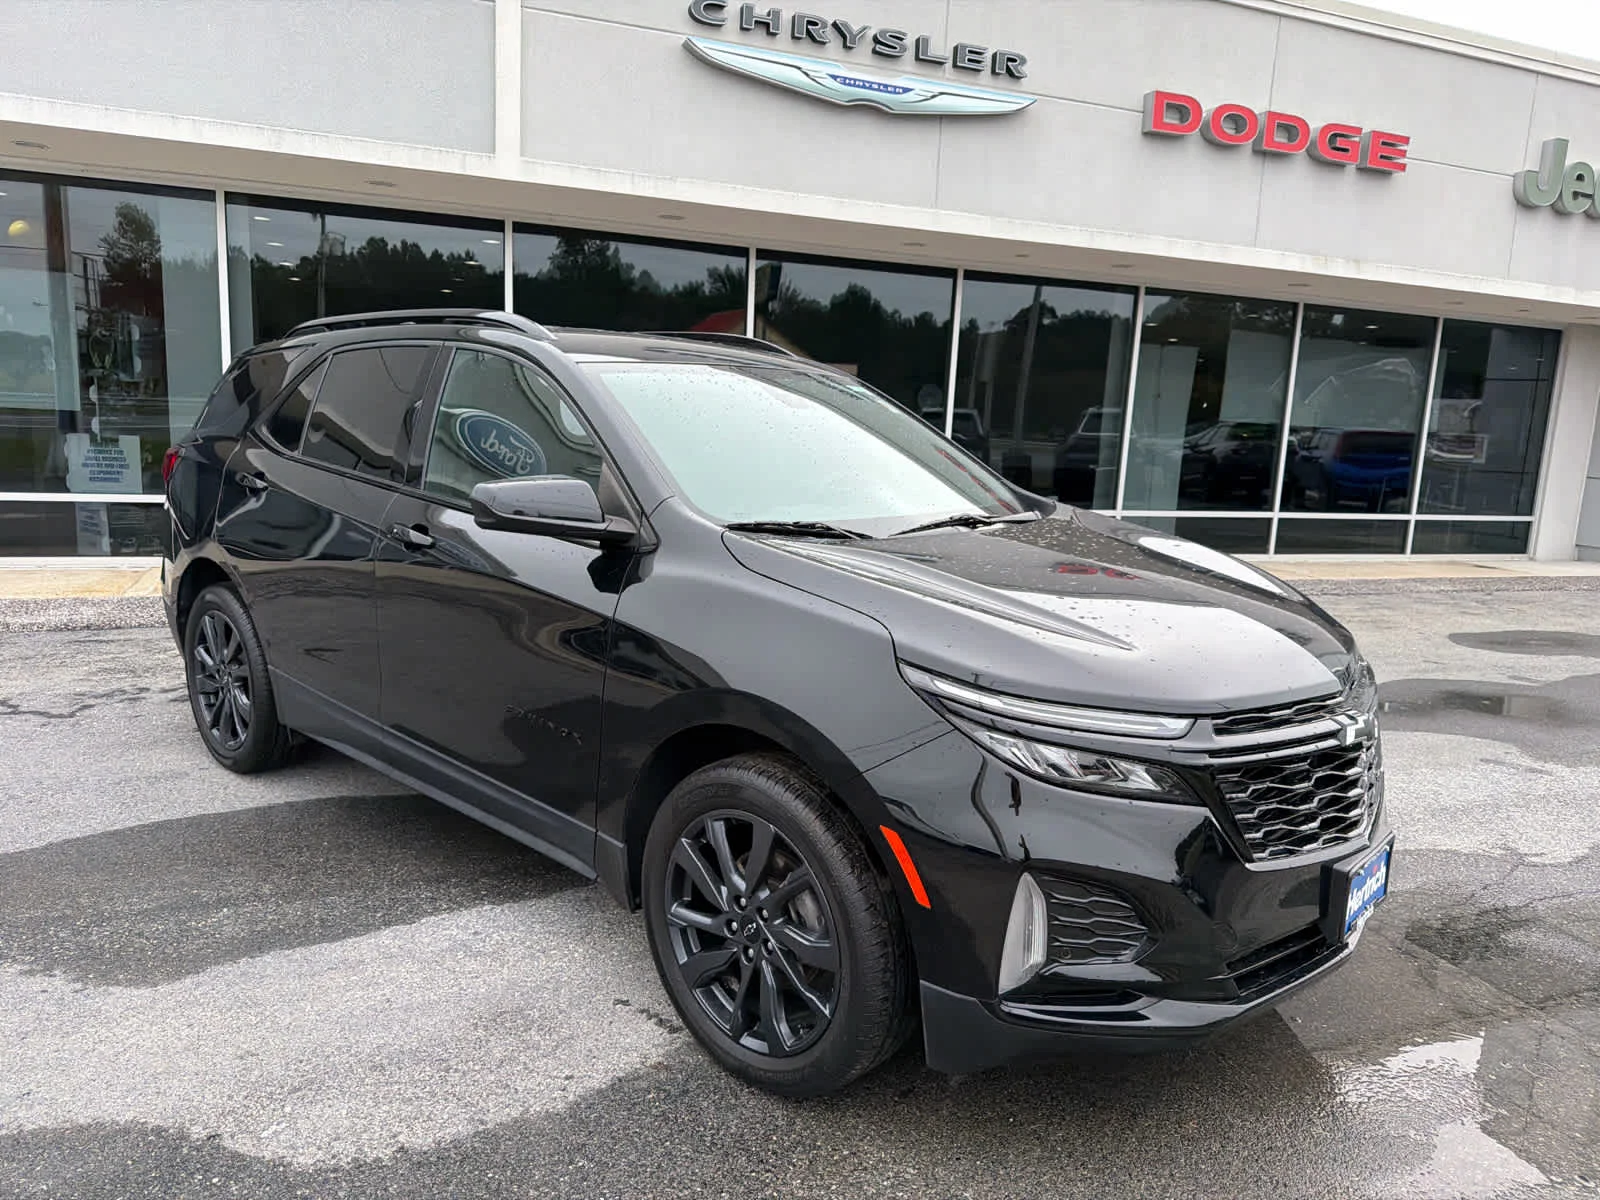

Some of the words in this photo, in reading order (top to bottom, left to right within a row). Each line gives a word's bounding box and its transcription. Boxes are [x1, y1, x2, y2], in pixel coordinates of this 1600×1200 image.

[688, 0, 1028, 79] CHRYSLER
[836, 77, 904, 94] CHRYSLER
[1143, 90, 1411, 174] DODGE
[1513, 137, 1600, 219] Je
